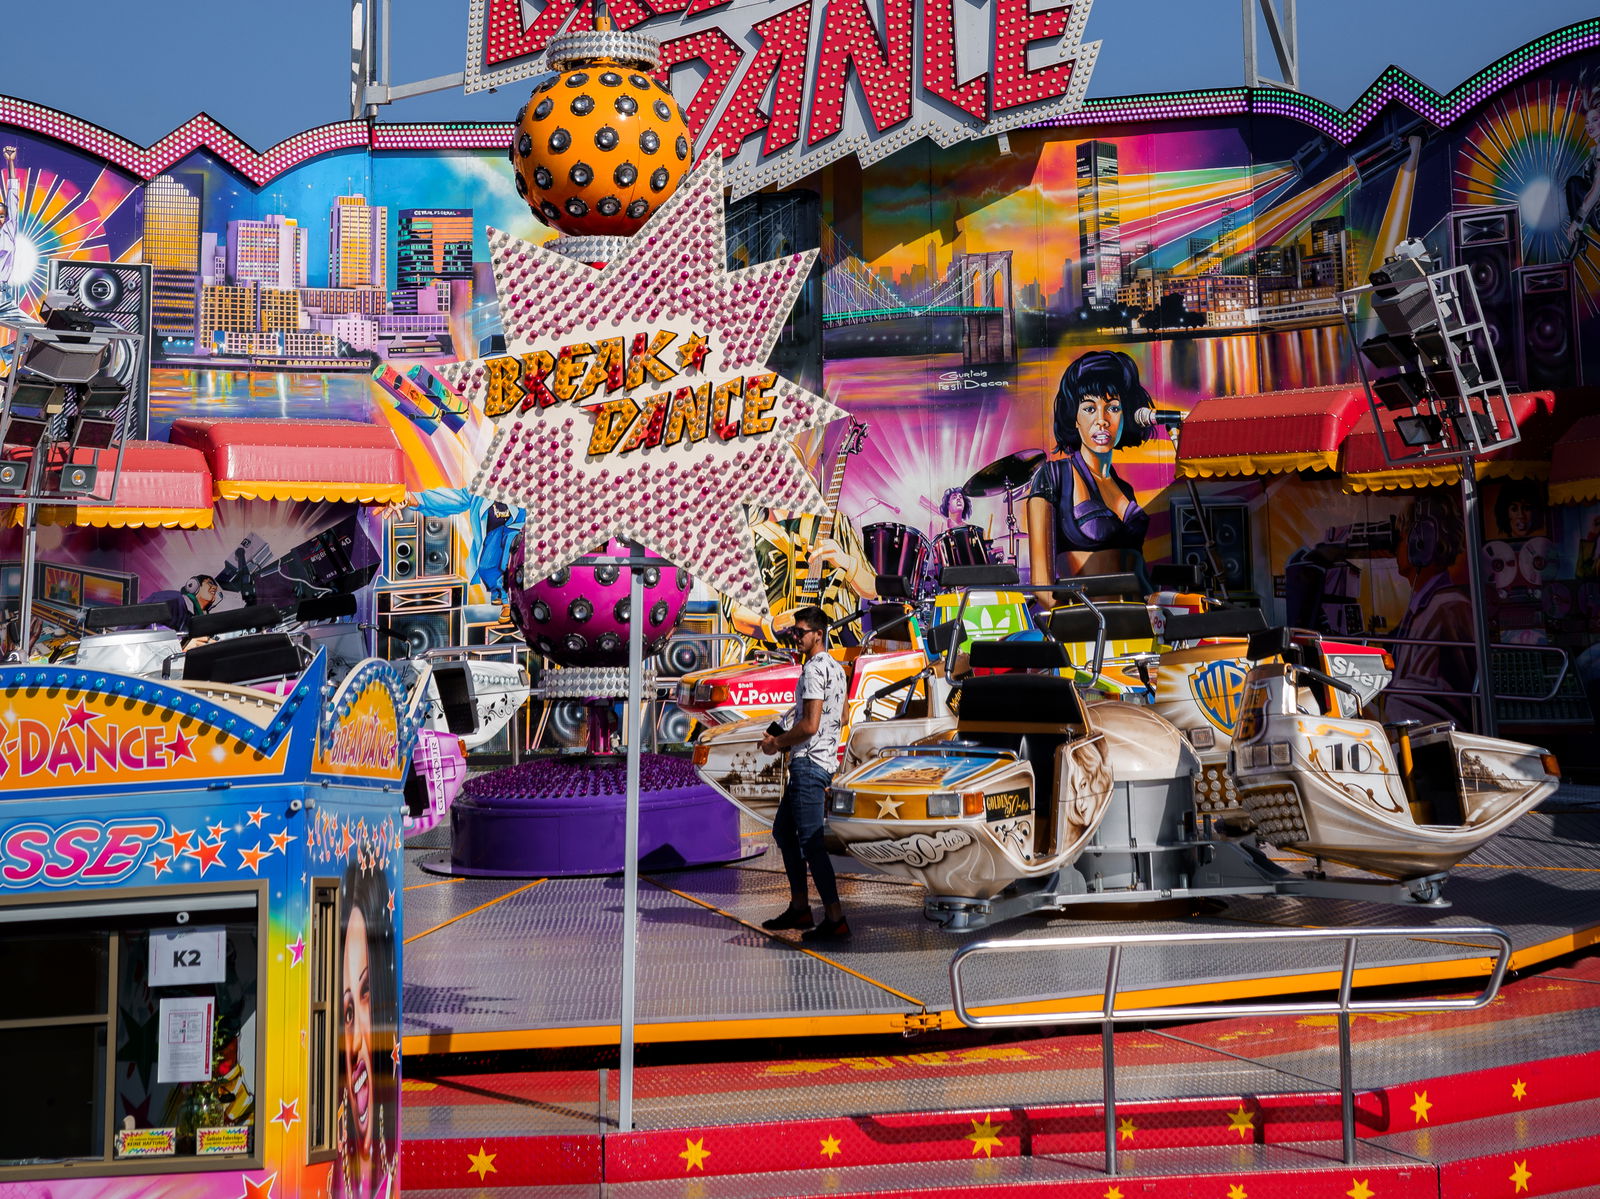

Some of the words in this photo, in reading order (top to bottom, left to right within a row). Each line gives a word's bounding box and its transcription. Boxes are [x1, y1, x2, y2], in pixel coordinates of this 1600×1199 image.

[484, 329, 680, 418] BREAK
[580, 371, 779, 456] DANCE
[1331, 655, 1388, 690] Shell
[0, 717, 168, 779] -DANCE
[431, 741, 444, 812] GLAMOUR
[1326, 743, 1372, 773] 10
[172, 950, 201, 968] K2
